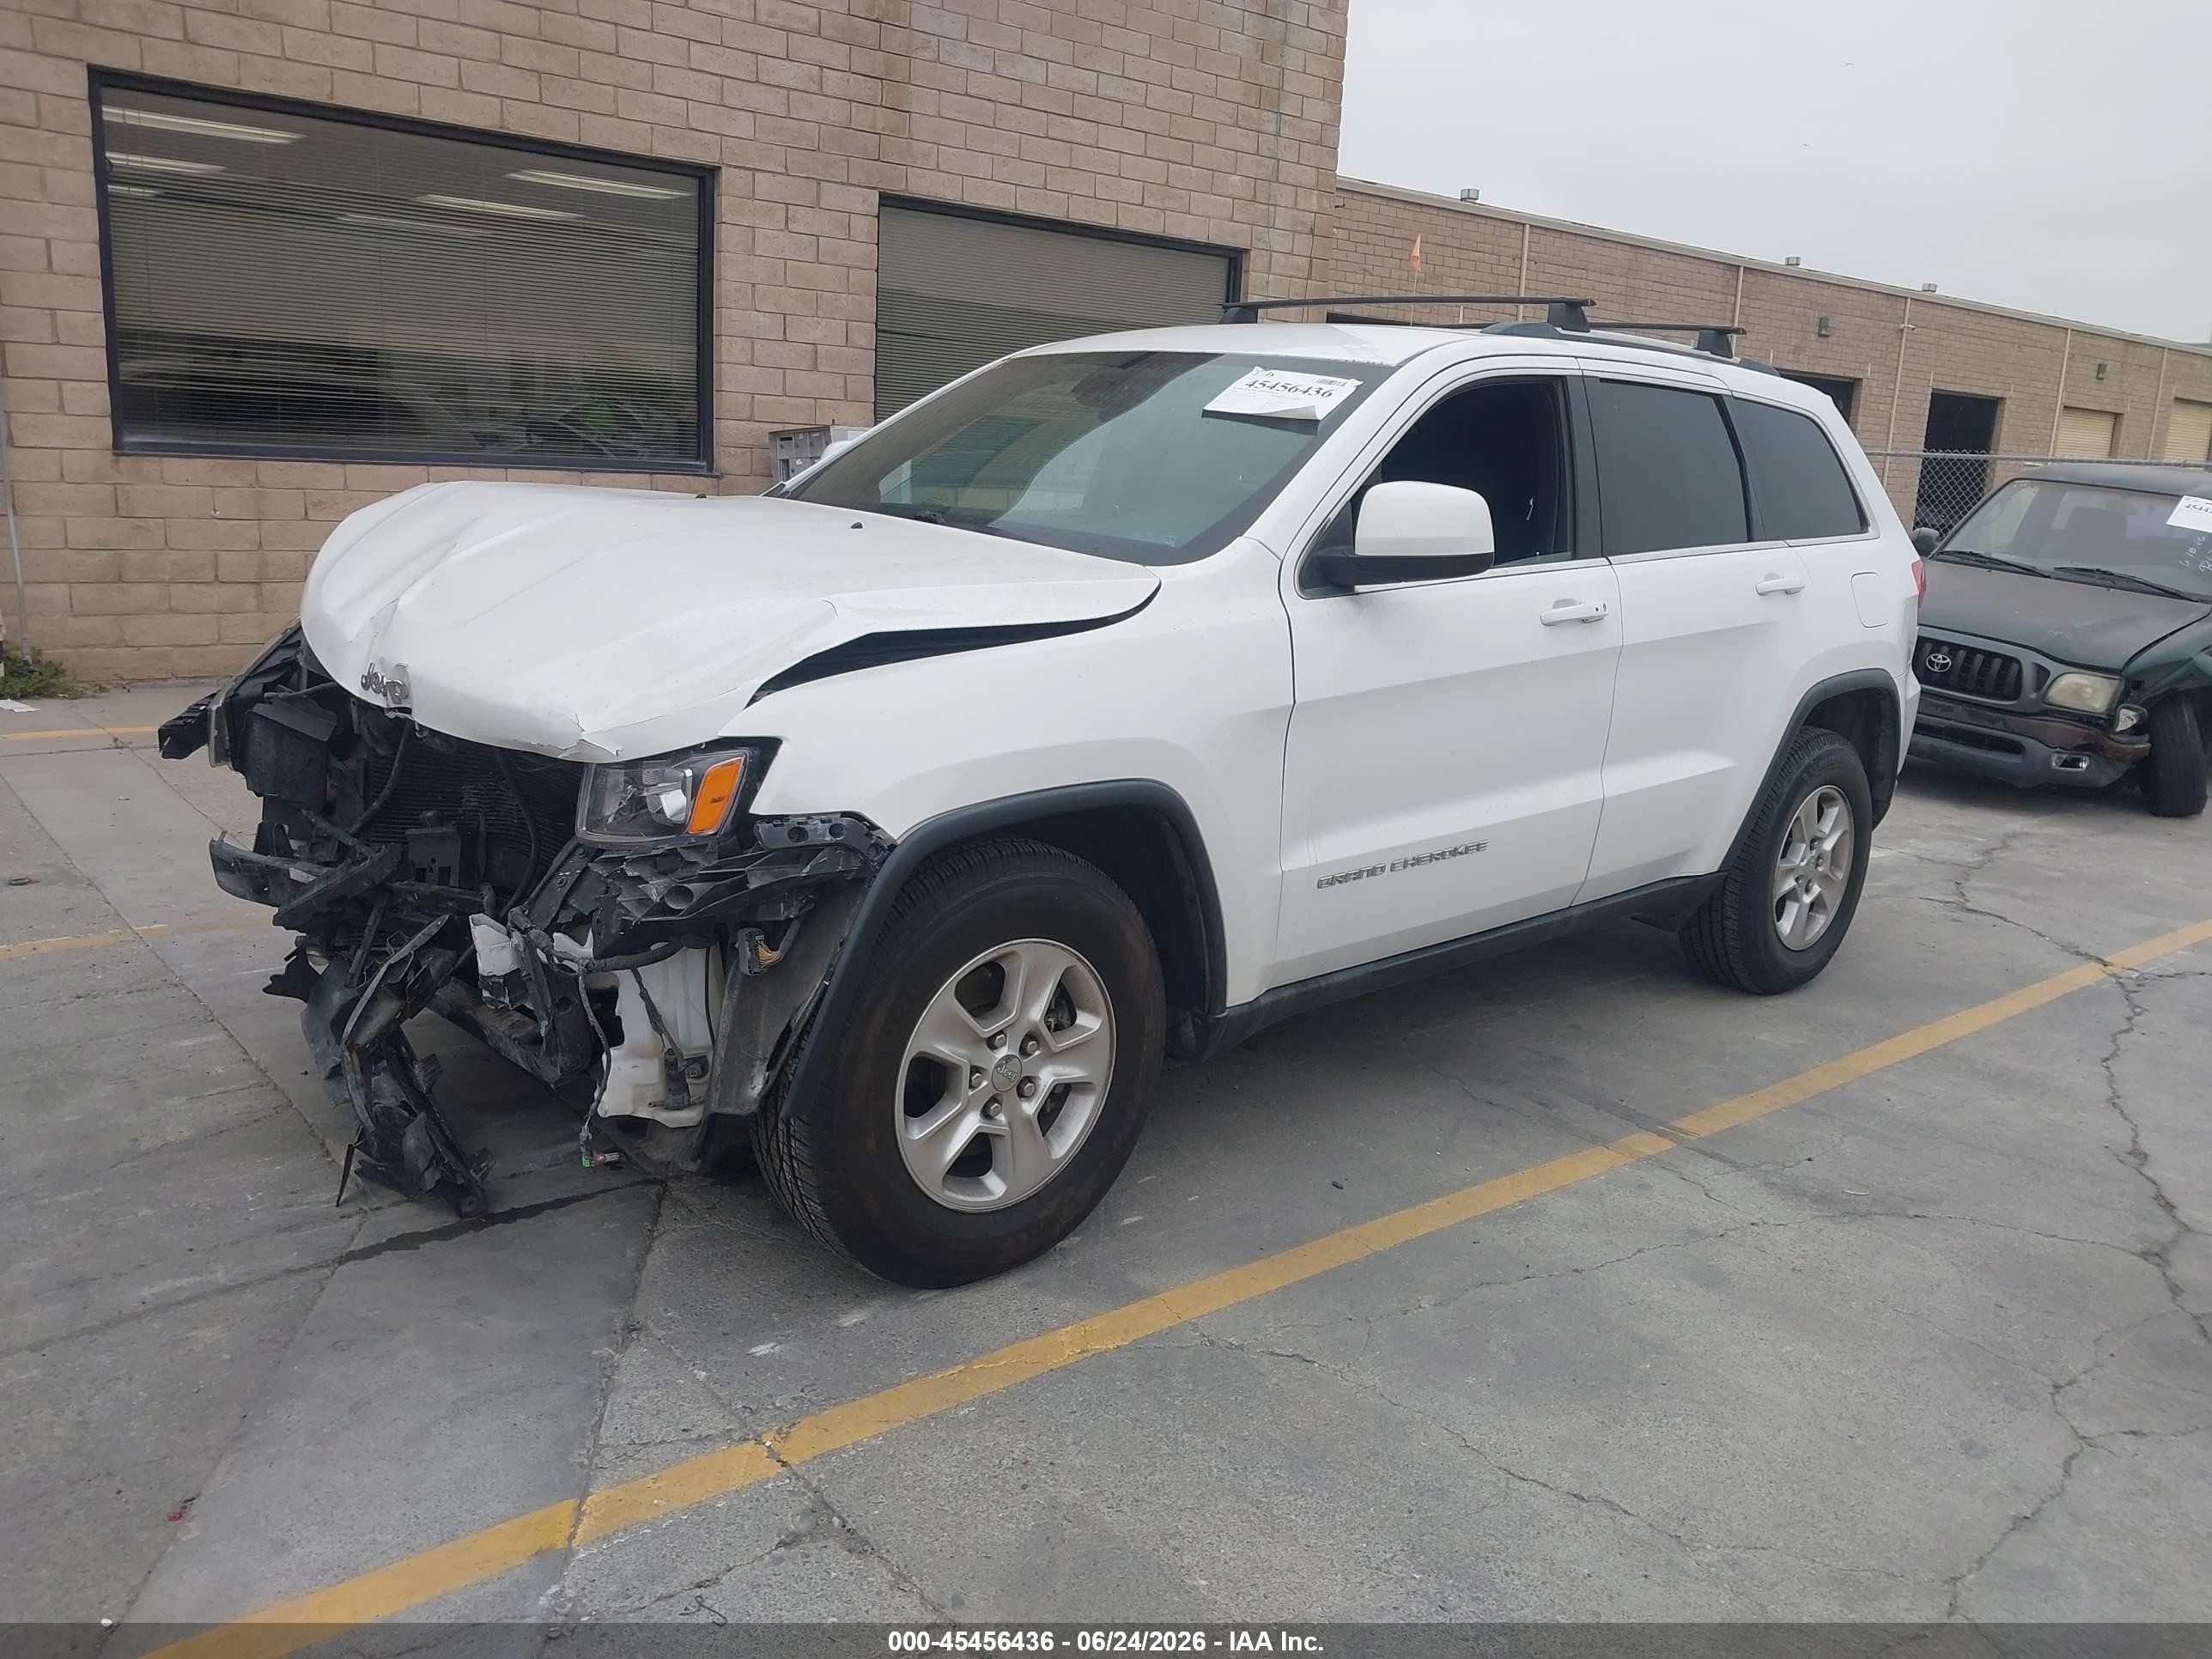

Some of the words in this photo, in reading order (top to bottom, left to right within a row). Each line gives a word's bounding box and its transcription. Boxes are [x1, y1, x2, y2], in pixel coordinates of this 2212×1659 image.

[1245, 380, 1336, 398] 45456436
[1316, 862, 1387, 889] GRAND
[1389, 838, 1492, 873] CHEROKEE
[997, 1063, 1018, 1083] Jeep
